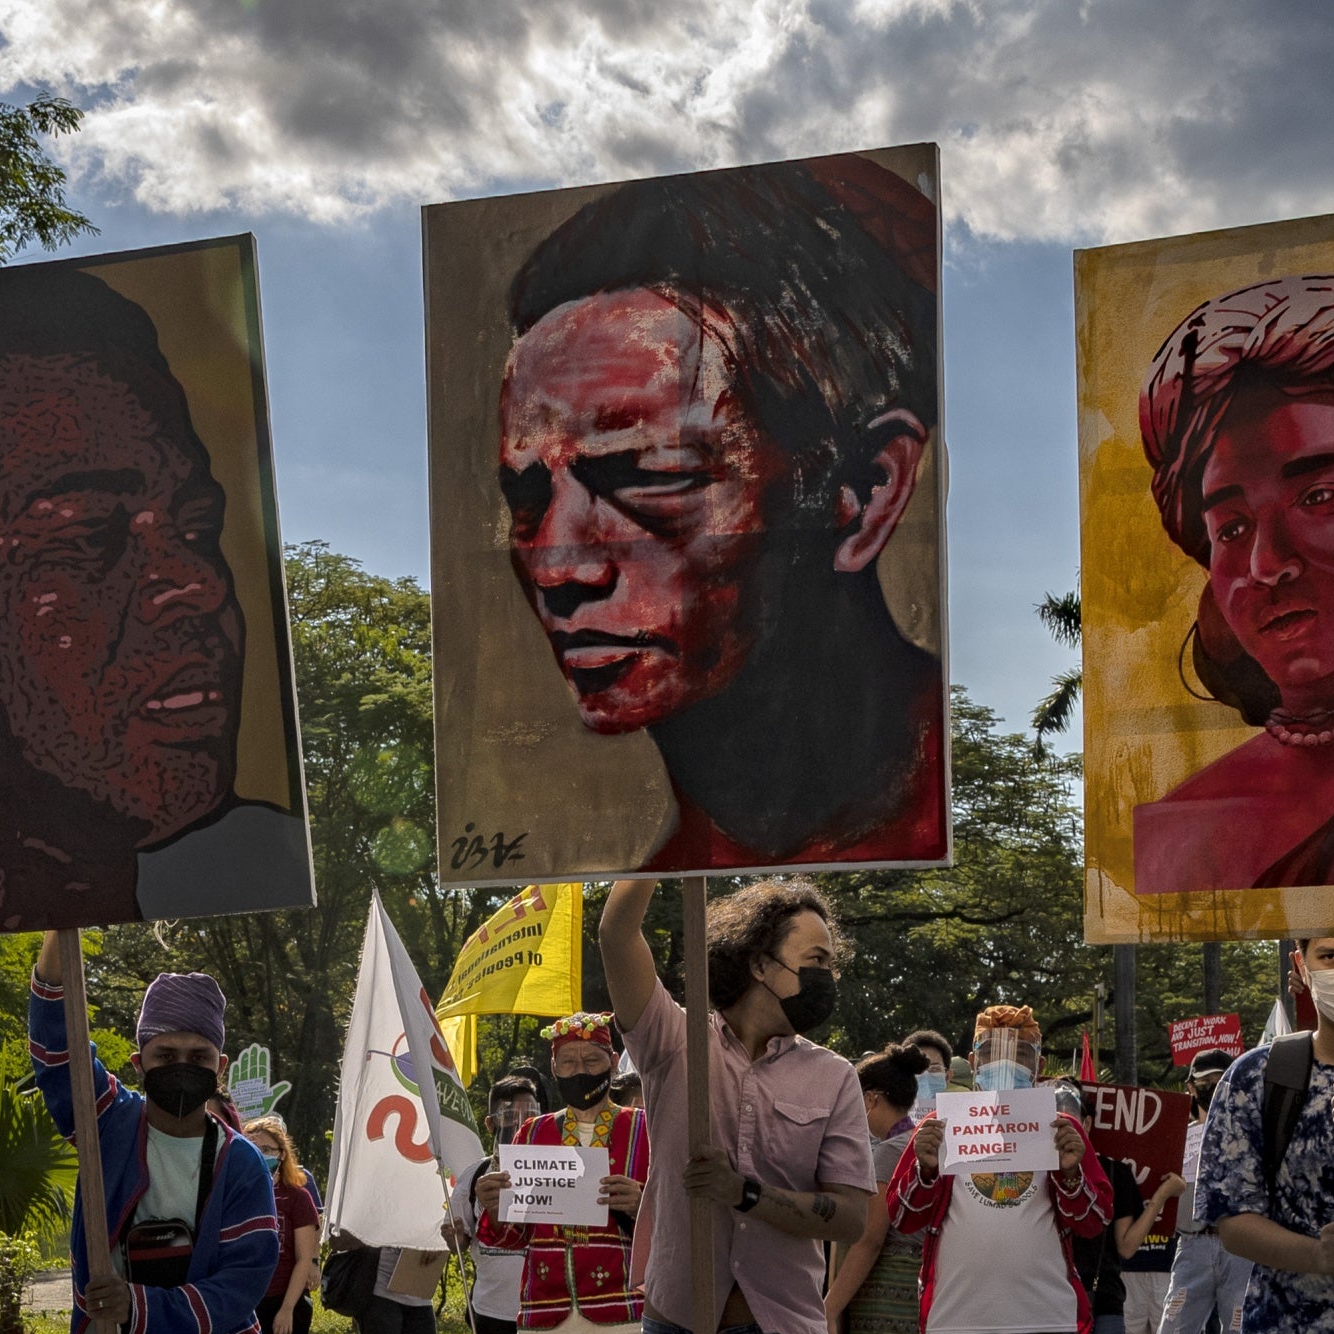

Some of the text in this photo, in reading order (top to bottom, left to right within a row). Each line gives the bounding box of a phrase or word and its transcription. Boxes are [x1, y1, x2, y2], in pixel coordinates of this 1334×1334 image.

[1203, 1015, 1227, 1026] WORK
[1187, 1025, 1215, 1040] JUST
[968, 1104, 1011, 1117] SAVE
[952, 1121, 1040, 1136] PANTARON
[958, 1142, 1018, 1156] RANGE!
[513, 1159, 578, 1171] CLIMATE
[514, 1177, 576, 1188] JUSTICE
[514, 1194, 553, 1206] NOW!
[964, 1181, 981, 1199] SAVE
[979, 1196, 1007, 1209] LUMAD
